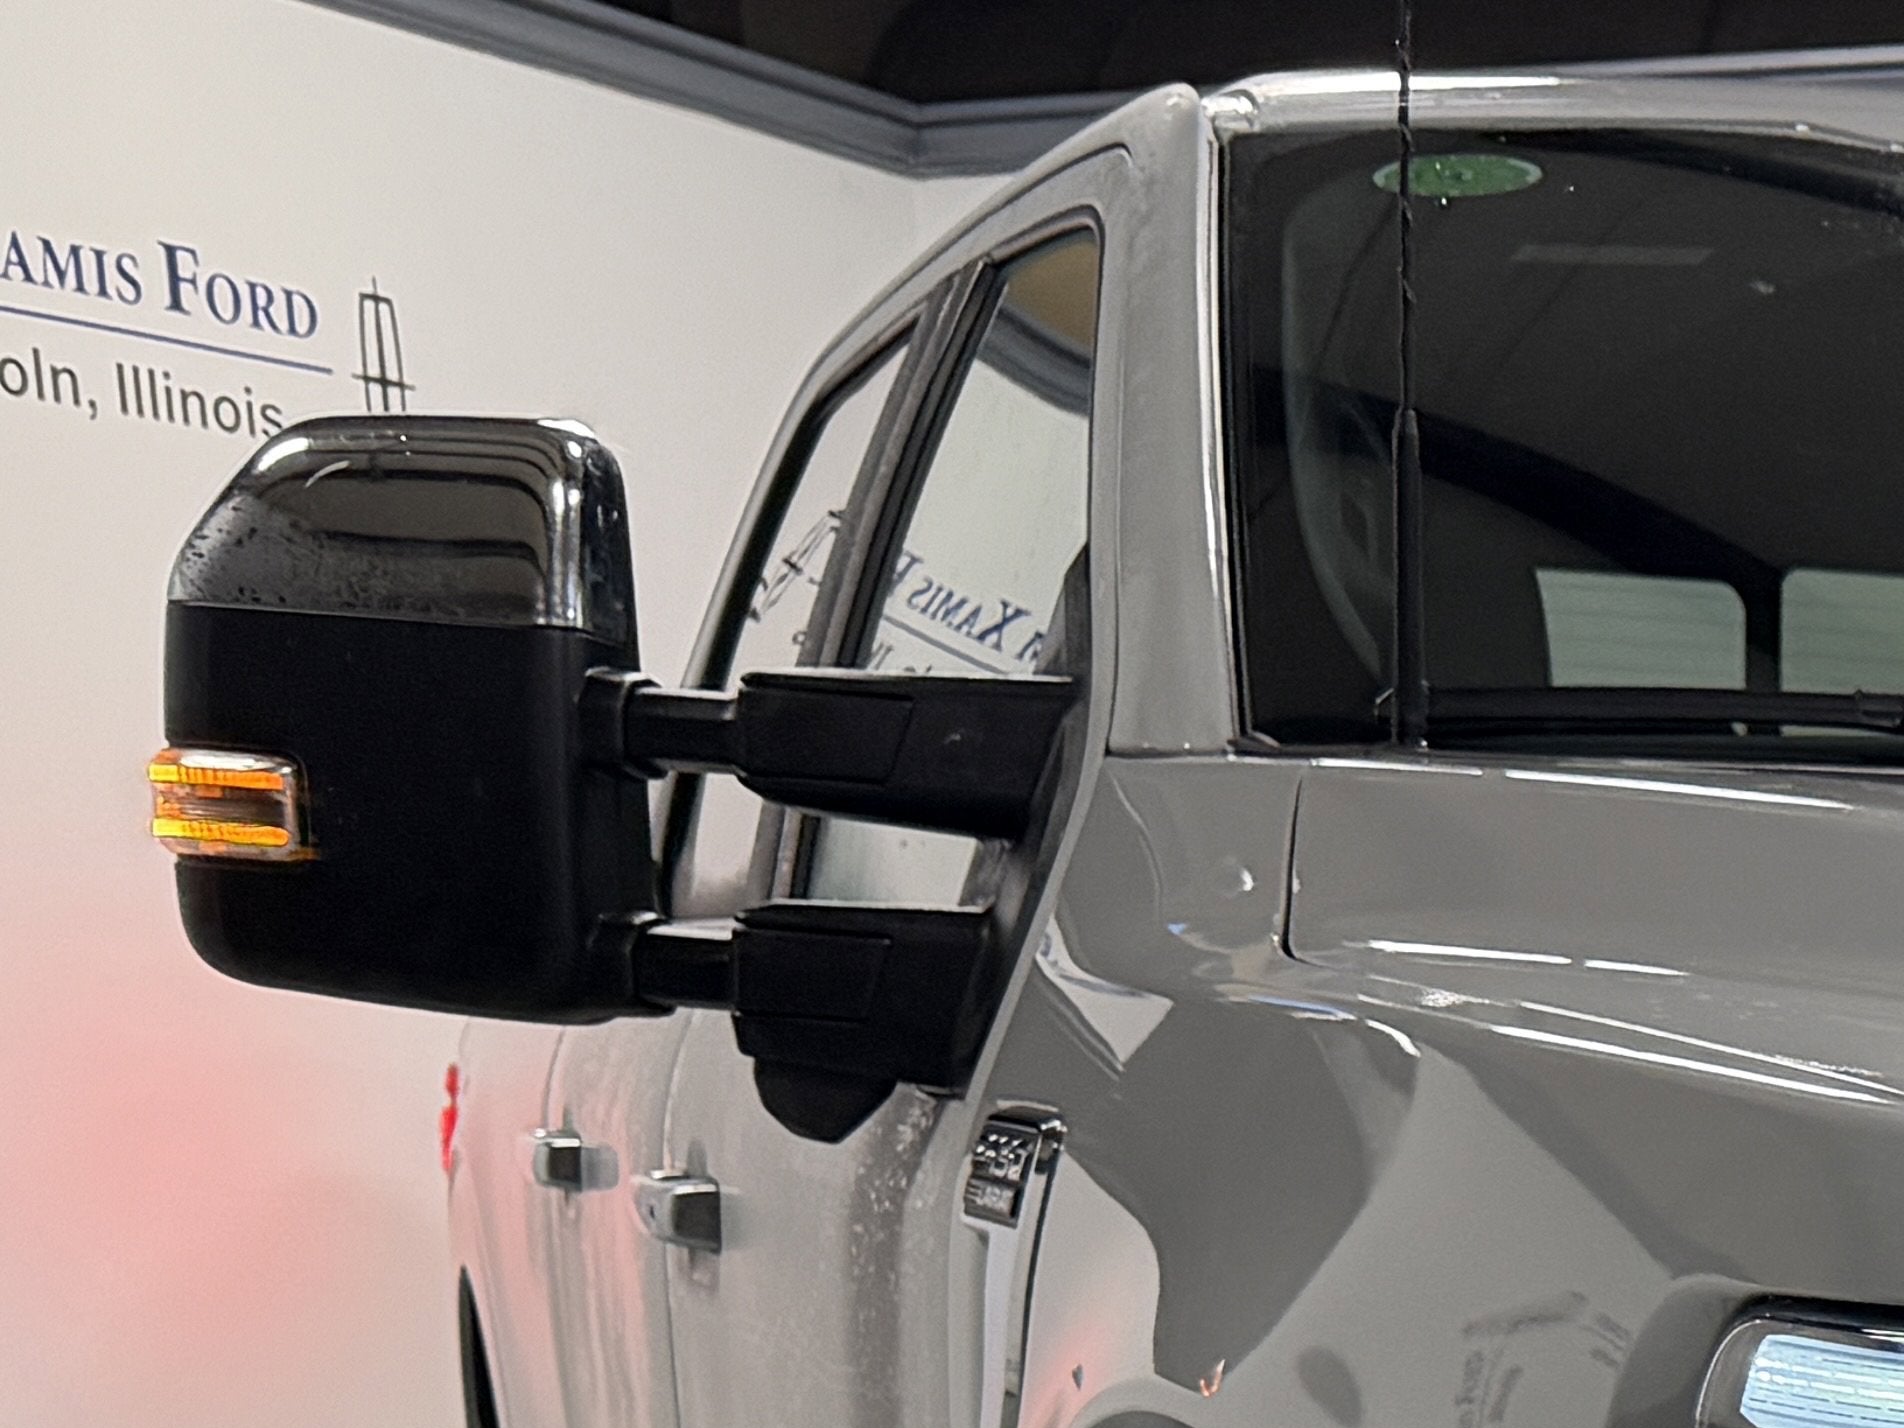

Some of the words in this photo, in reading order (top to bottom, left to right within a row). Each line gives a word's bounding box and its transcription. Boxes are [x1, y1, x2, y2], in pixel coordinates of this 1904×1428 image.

[0, 230, 142, 305] AMIS
[157, 239, 319, 339] FORD
[0, 346, 98, 421] oln,
[115, 361, 284, 438] Illinois
